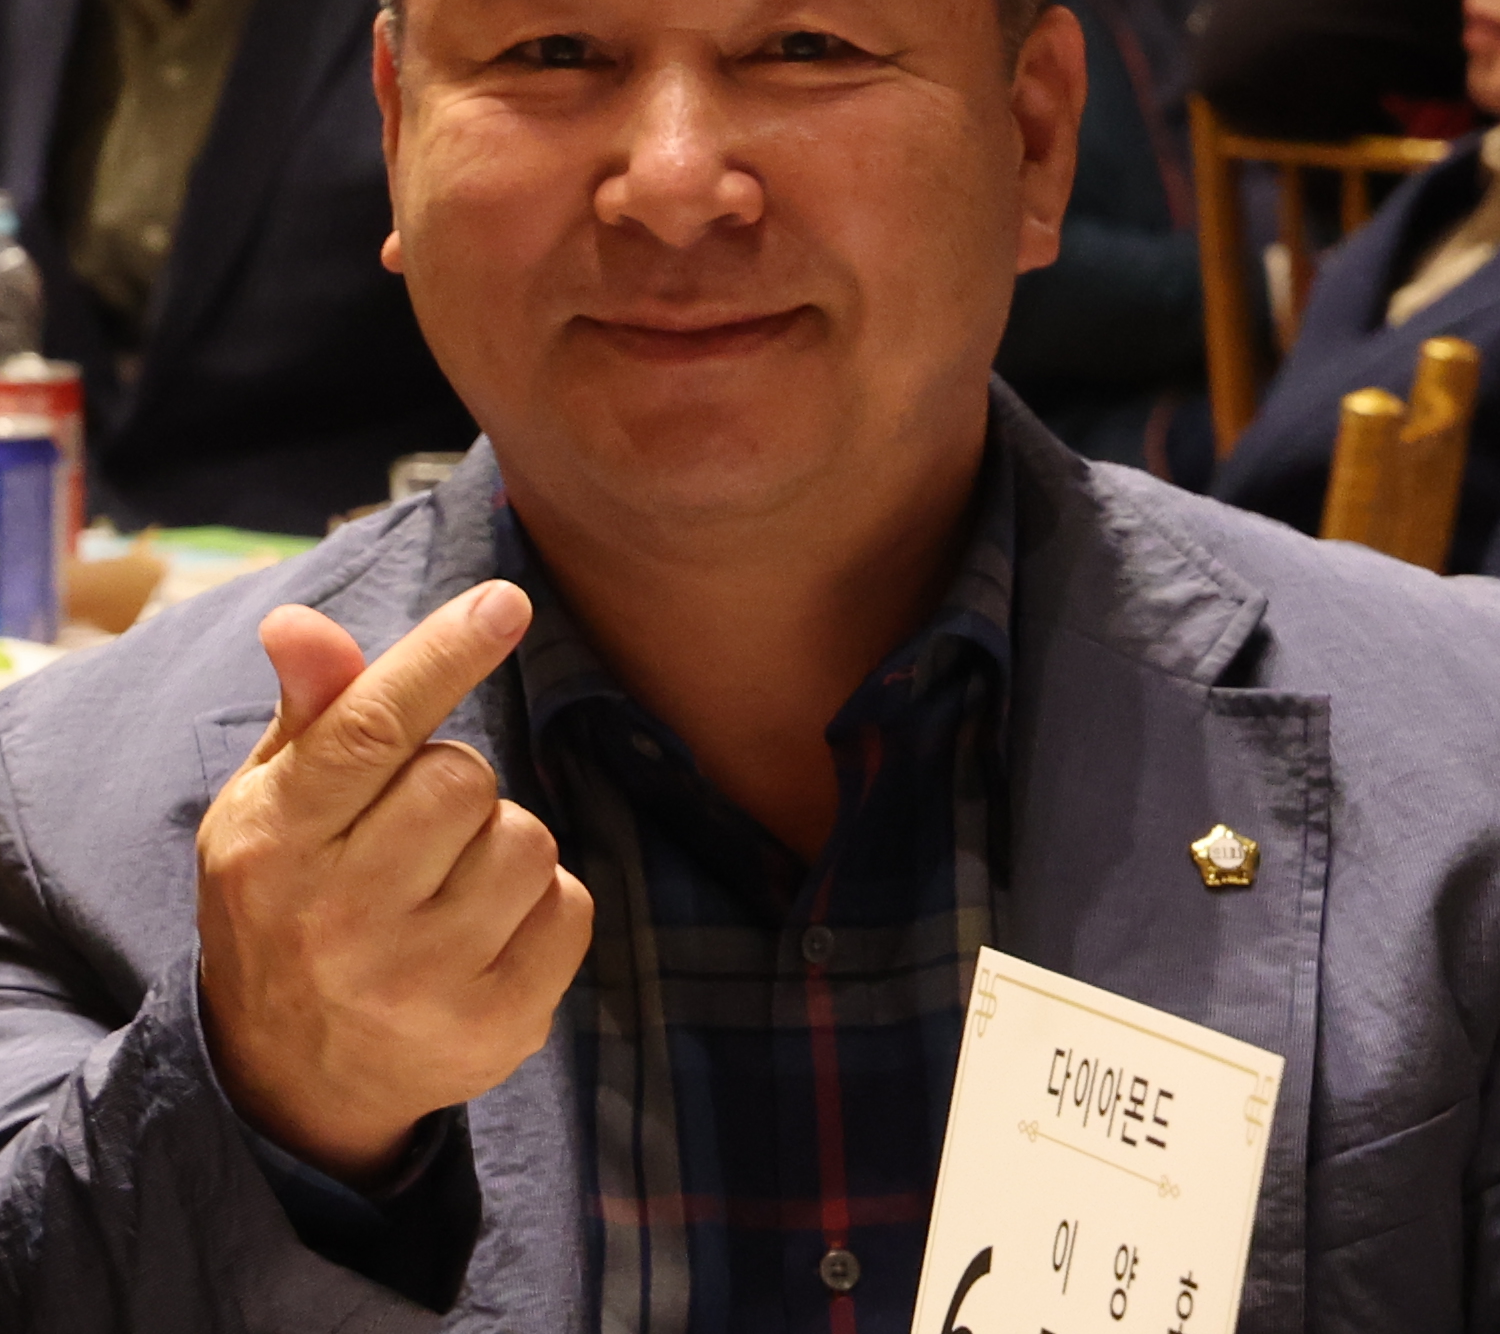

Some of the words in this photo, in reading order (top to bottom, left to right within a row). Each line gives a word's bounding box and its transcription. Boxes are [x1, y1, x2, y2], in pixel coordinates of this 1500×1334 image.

[1048, 1048, 1174, 1149] 다이아몬드
[1053, 1220, 1078, 1296] 이
[1110, 1244, 1139, 1321] 양
